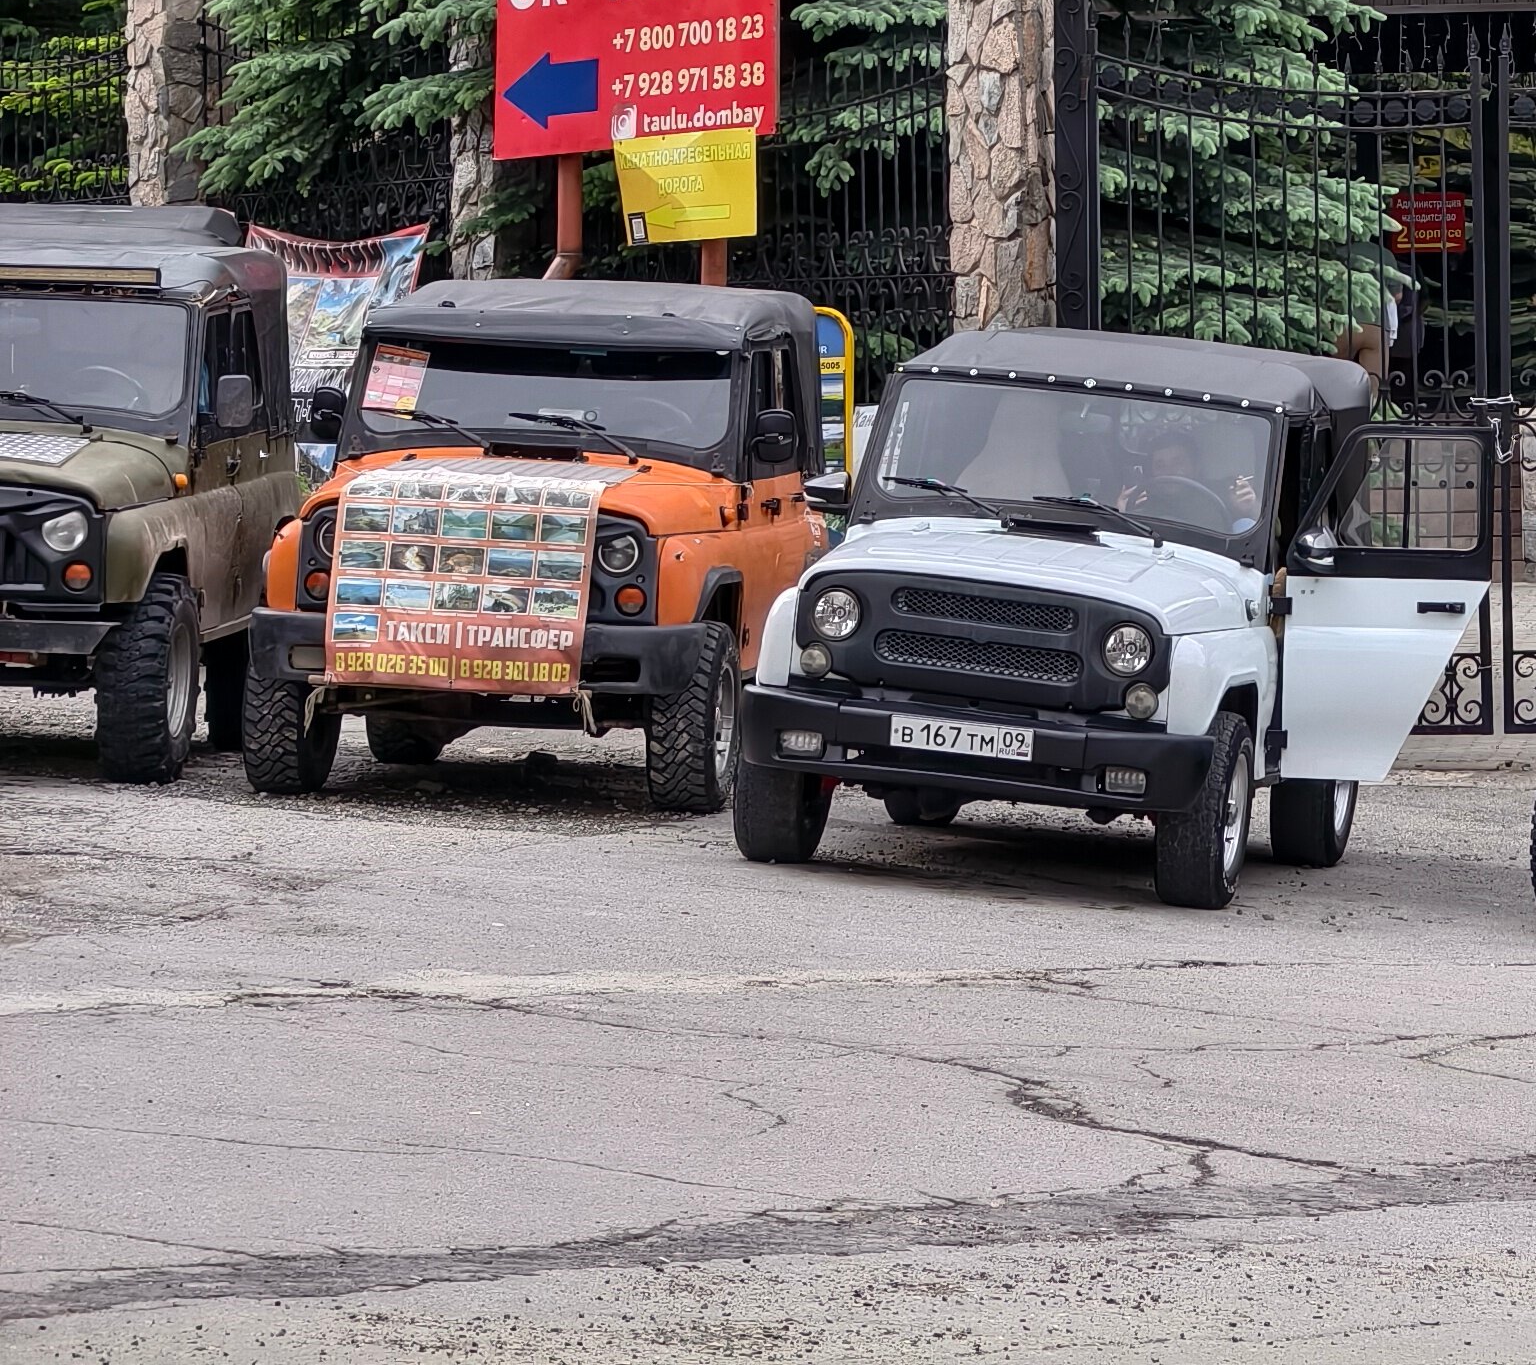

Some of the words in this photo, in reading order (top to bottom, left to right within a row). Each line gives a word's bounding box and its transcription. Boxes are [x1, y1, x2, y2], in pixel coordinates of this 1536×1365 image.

[612, 28, 634, 53] +7
[639, 22, 674, 51] 800
[678, 19, 712, 48] 700
[715, 16, 737, 43] 18
[741, 14, 764, 40] 23
[611, 74, 634, 99] +7
[638, 69, 673, 97] 928
[678, 66, 708, 93] 971
[711, 63, 737, 89] 58
[740, 61, 765, 87] 38
[643, 101, 765, 133] taulu.dombay
[620, 142, 751, 169] КАНАТНО-КРЕСЕЛЬНАЯ
[658, 175, 704, 198] ДОРОГА
[1397, 226, 1408, 242] 2
[386, 620, 450, 645] ТАКСИ
[467, 625, 573, 651] ТРАНСФЕР
[335, 652, 345, 672] 8
[347, 652, 374, 672] 928
[408, 656, 426, 675] 35
[460, 659, 470, 678] 8
[473, 659, 501, 679] 928
[551, 663, 571, 682] 03
[1003, 731, 1026, 751] 09
